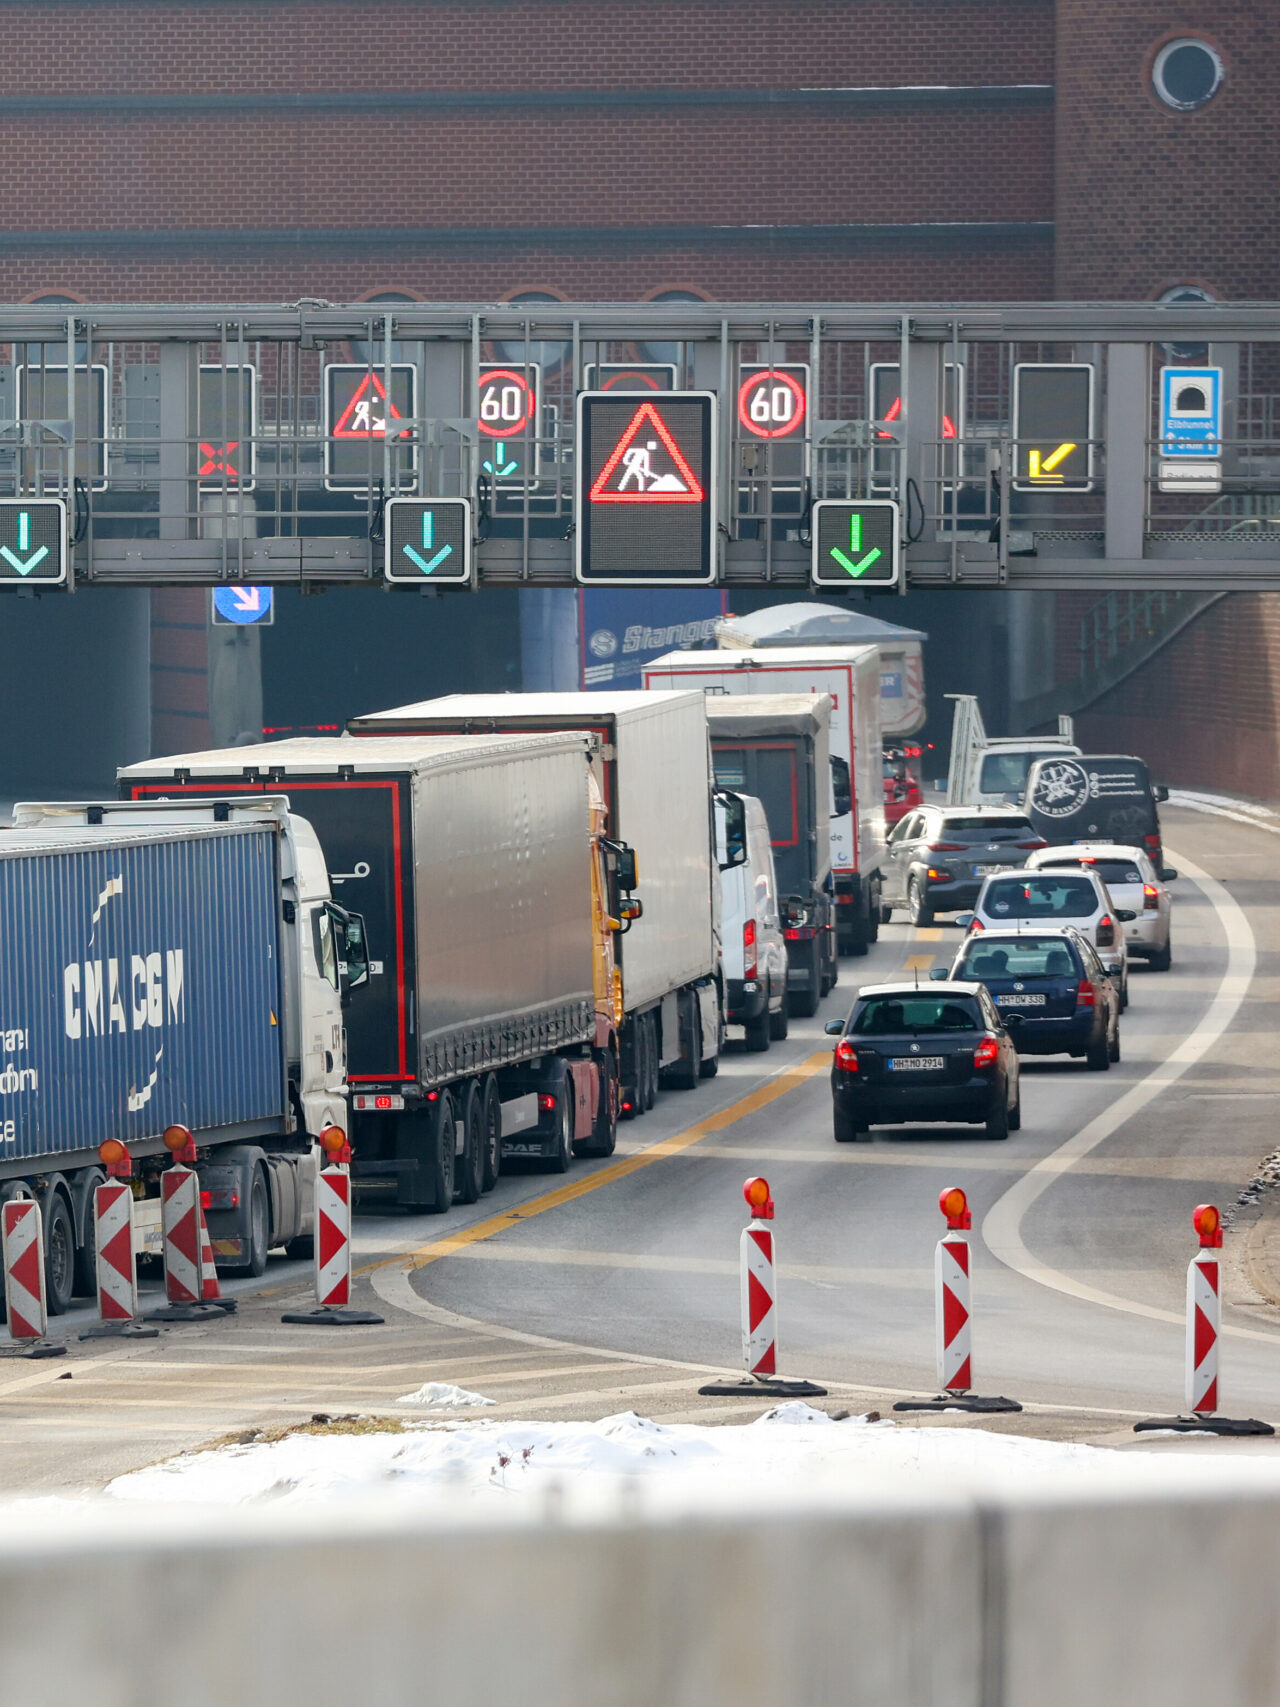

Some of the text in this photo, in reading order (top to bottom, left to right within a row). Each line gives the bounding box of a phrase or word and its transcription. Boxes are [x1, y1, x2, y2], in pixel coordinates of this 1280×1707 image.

[481, 386, 521, 420] 60
[750, 386, 792, 422] 60
[1167, 419, 1215, 429] Elbtunnel
[893, 1059, 904, 1069] HH
[922, 1056, 943, 1068] 2914
